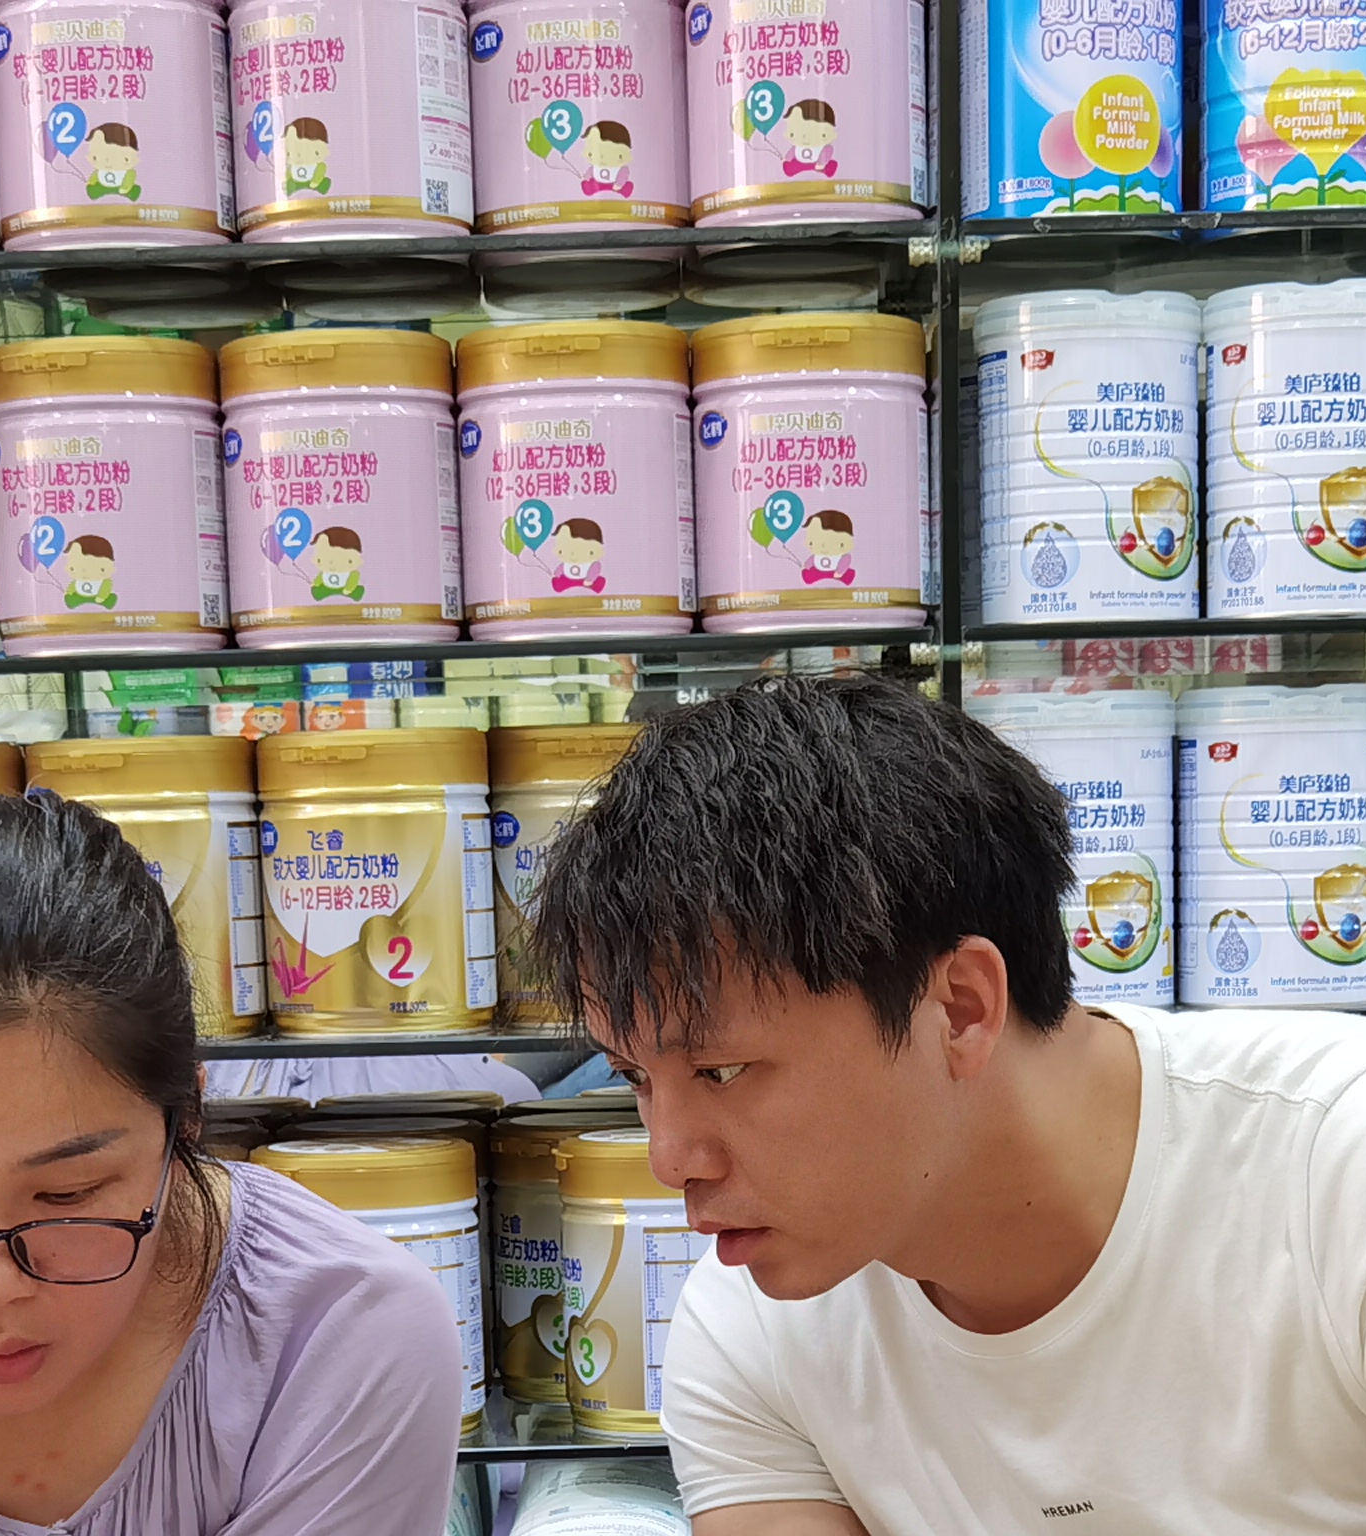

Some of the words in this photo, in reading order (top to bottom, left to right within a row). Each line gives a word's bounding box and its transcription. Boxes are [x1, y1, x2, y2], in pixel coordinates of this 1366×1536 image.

[722, 20, 840, 54] 幼儿配方奶粉
[514, 45, 634, 75] 幼儿配方奶粉
[751, 88, 775, 122] 3
[1092, 106, 1151, 123] Formula
[1101, 91, 1145, 108] Infant
[1299, 97, 1343, 112] Infant
[53, 111, 77, 144] 2
[257, 110, 273, 142] 2
[549, 107, 573, 142] 3
[1106, 120, 1136, 135] Milk
[1273, 113, 1334, 130] Formula
[1336, 110, 1366, 126] Milk
[1291, 125, 1349, 142] Powder
[1095, 134, 1150, 151] Powder
[1097, 382, 1166, 403] 美庐臻铂
[1283, 372, 1361, 395] 美庐臻铂
[1067, 407, 1185, 435] 婴儿配方奶粉
[491, 443, 606, 473] 幼儿配方奶粉
[739, 435, 857, 466] 幼儿配方奶粉
[242, 452, 379, 482] 较大婴儿配方奶粉
[522, 507, 543, 539] 3
[771, 498, 794, 530] 3
[35, 524, 56, 556] 2
[281, 514, 303, 547] 2
[1279, 773, 1351, 793] 美庐臻铂
[273, 853, 400, 880] 较大婴儿配方奶粉
[387, 936, 415, 980] 2
[579, 1336, 596, 1379] 3
